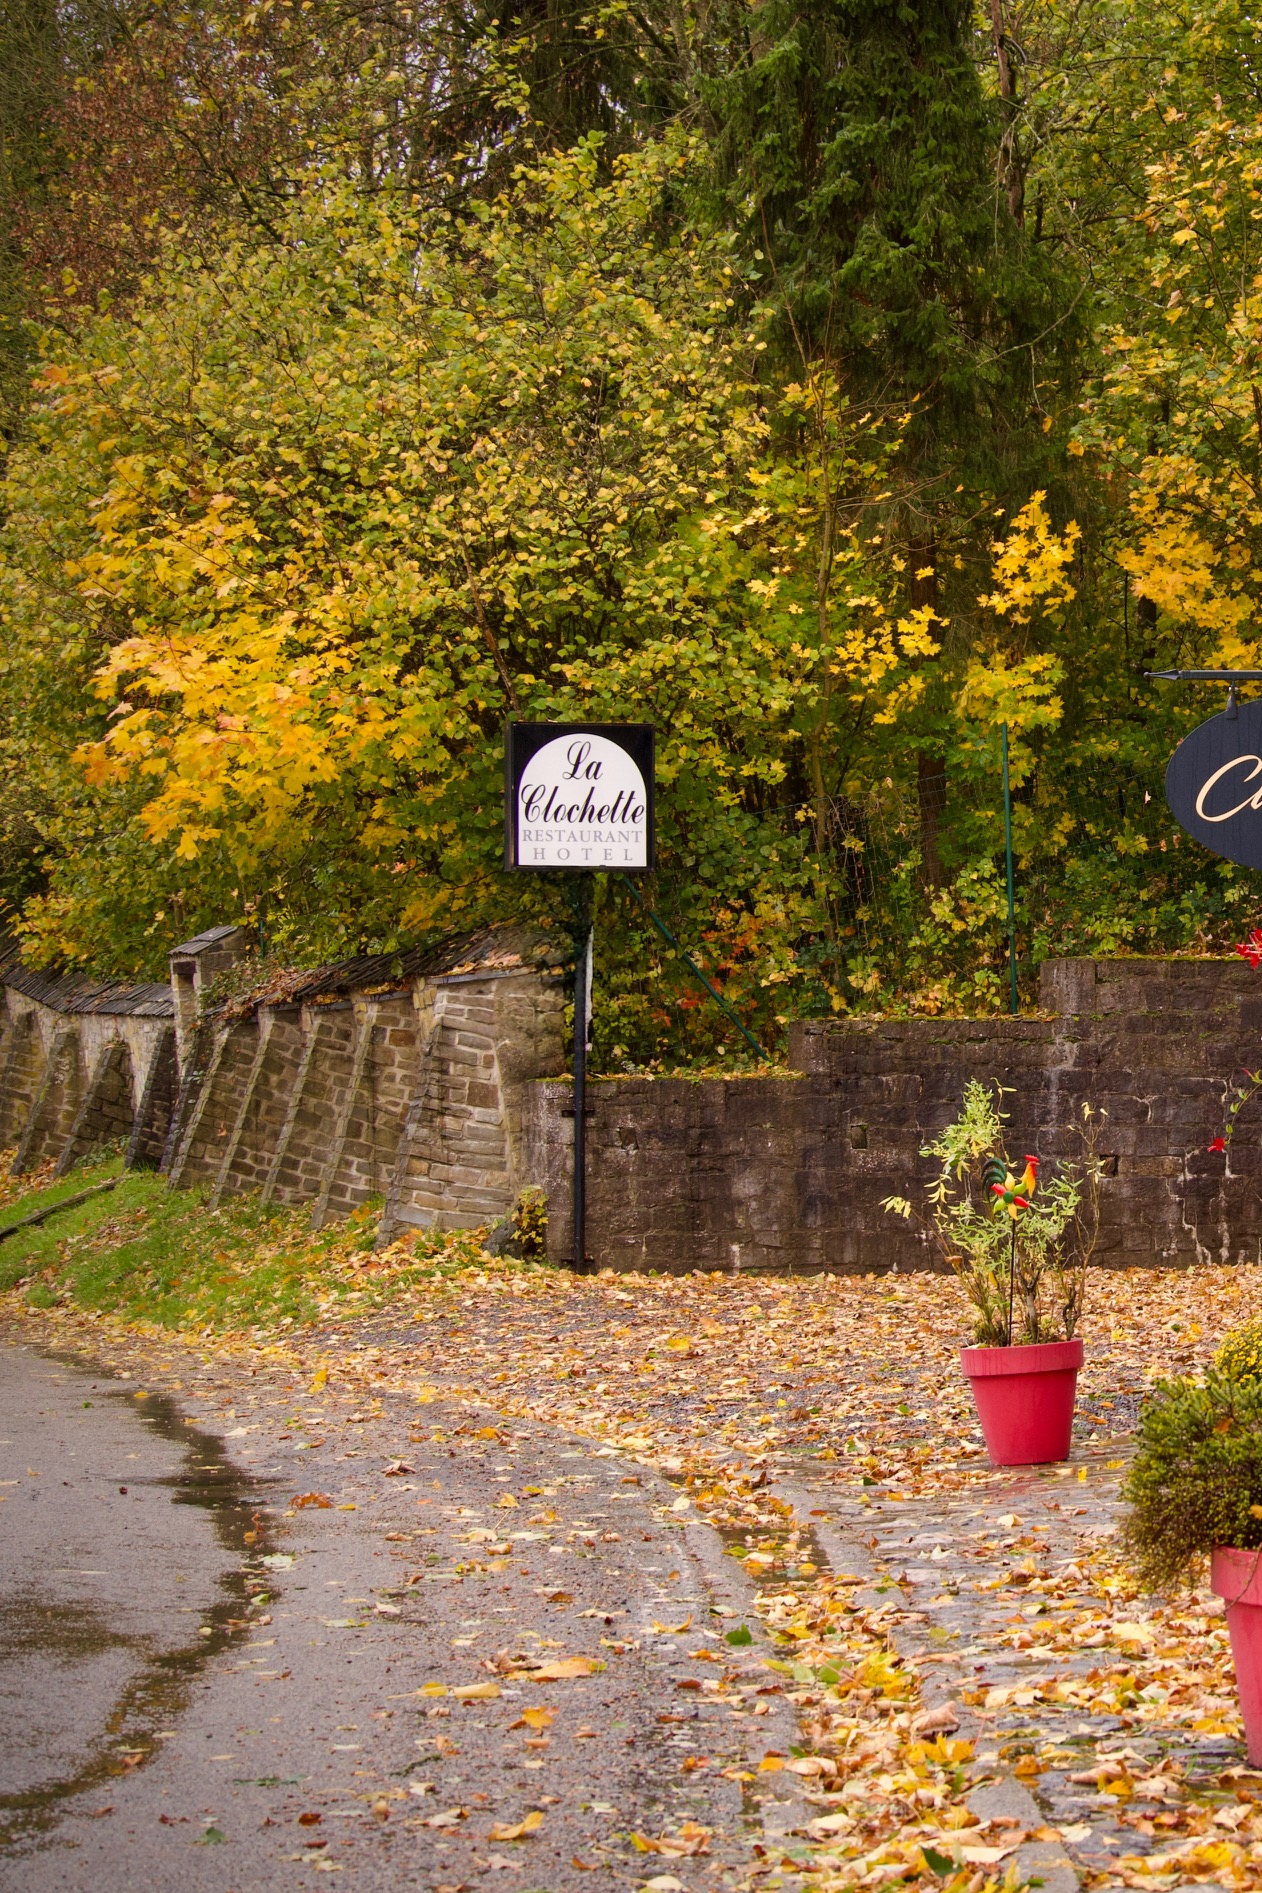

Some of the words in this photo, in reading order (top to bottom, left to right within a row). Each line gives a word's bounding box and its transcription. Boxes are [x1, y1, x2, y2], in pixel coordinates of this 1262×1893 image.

[562, 741, 603, 780] La
[521, 784, 645, 824] Clochette
[522, 829, 643, 843] RESTAURANT
[533, 847, 633, 861] HOTEL
